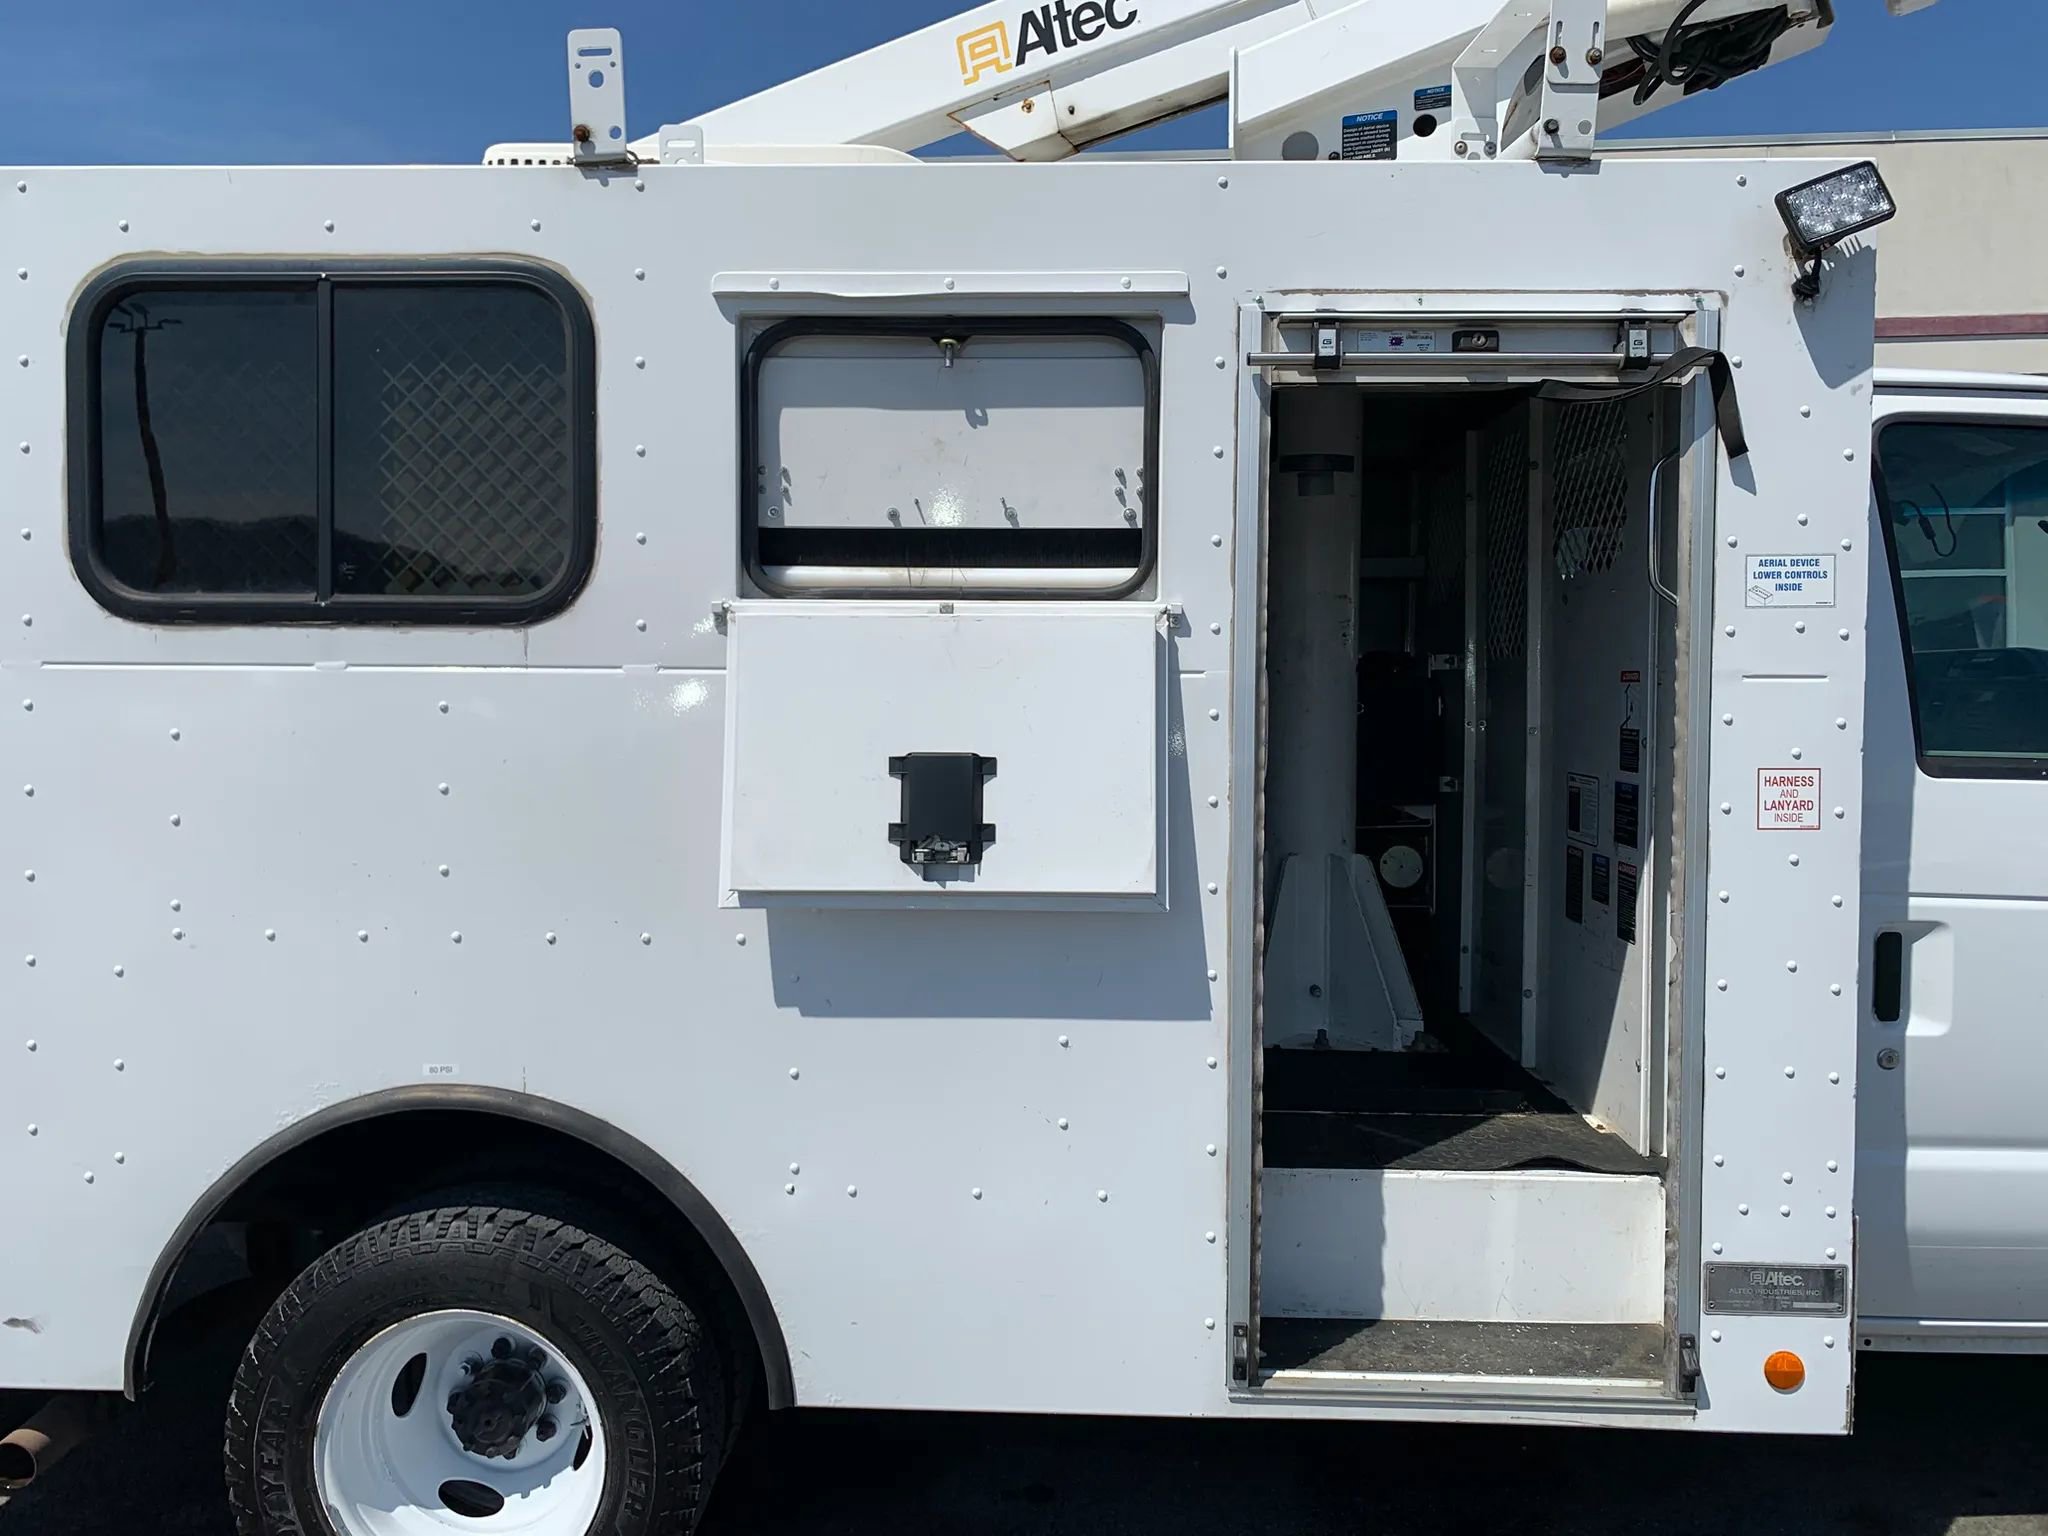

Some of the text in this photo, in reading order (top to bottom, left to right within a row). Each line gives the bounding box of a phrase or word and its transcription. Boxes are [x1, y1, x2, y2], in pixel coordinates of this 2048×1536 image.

[1015, 0, 1138, 67] Altec
[1356, 112, 1384, 122] NOTICE
[1758, 558, 1821, 568] AERIAL DEVICE
[1753, 570, 1828, 580] LOWER CONTROLS
[1775, 583, 1803, 591] INSIDE
[1764, 776, 1814, 787] HARNESS
[1779, 789, 1799, 799] AND
[1764, 800, 1814, 811] LANYARD
[1774, 813, 1804, 823] INSIDE
[440, 1065, 453, 1073] PSI
[1728, 1288, 1752, 1296] ALTEC
